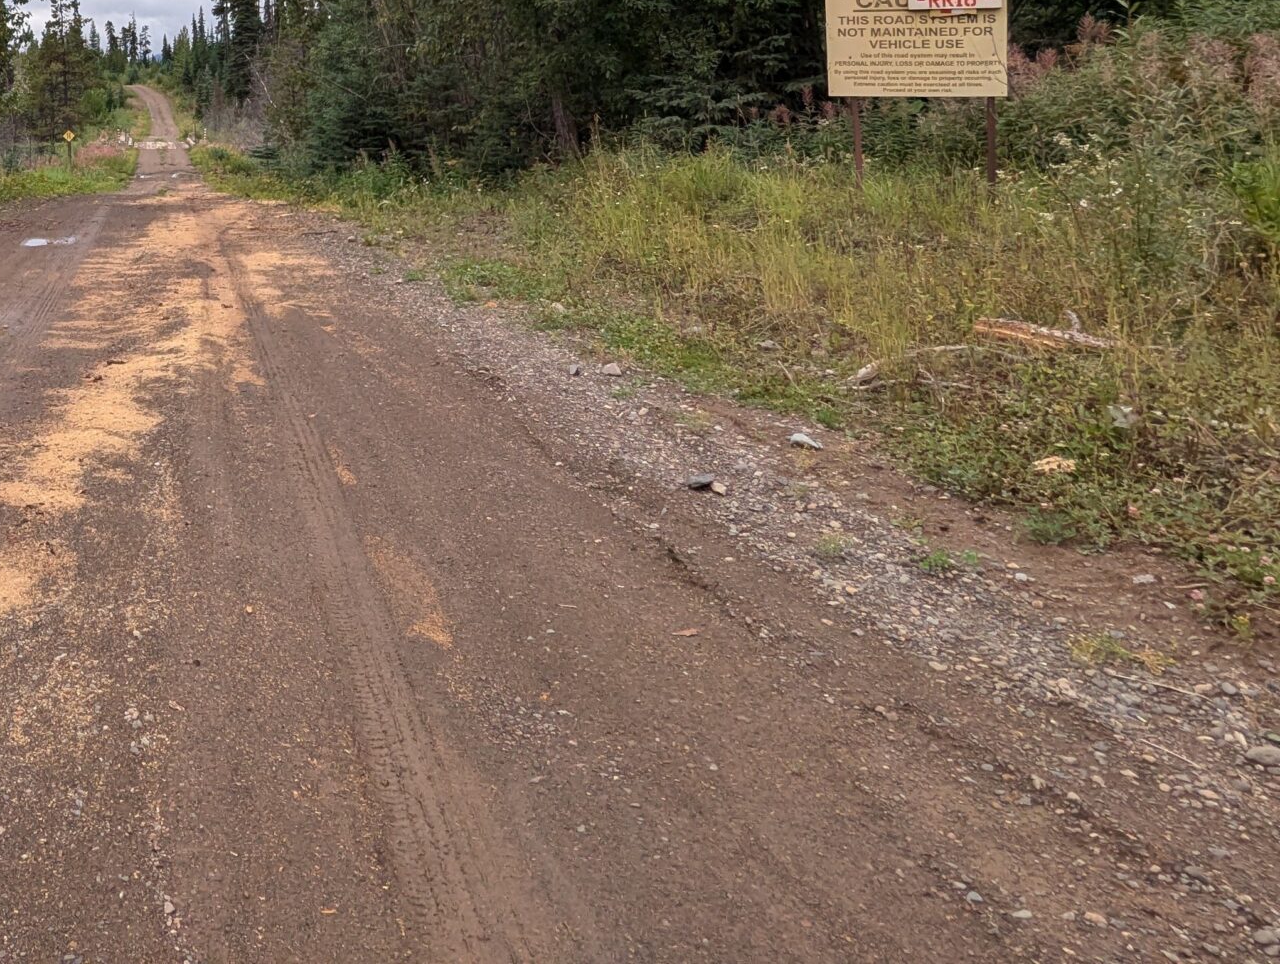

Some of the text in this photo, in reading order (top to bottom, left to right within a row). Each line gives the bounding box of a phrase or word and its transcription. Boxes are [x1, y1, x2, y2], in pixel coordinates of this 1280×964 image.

[838, 14, 996, 25] THIS ROAD SYSTEM IS
[838, 26, 993, 37] NOT MAINTAINED FOR
[869, 39, 964, 49] VEHICLE USE
